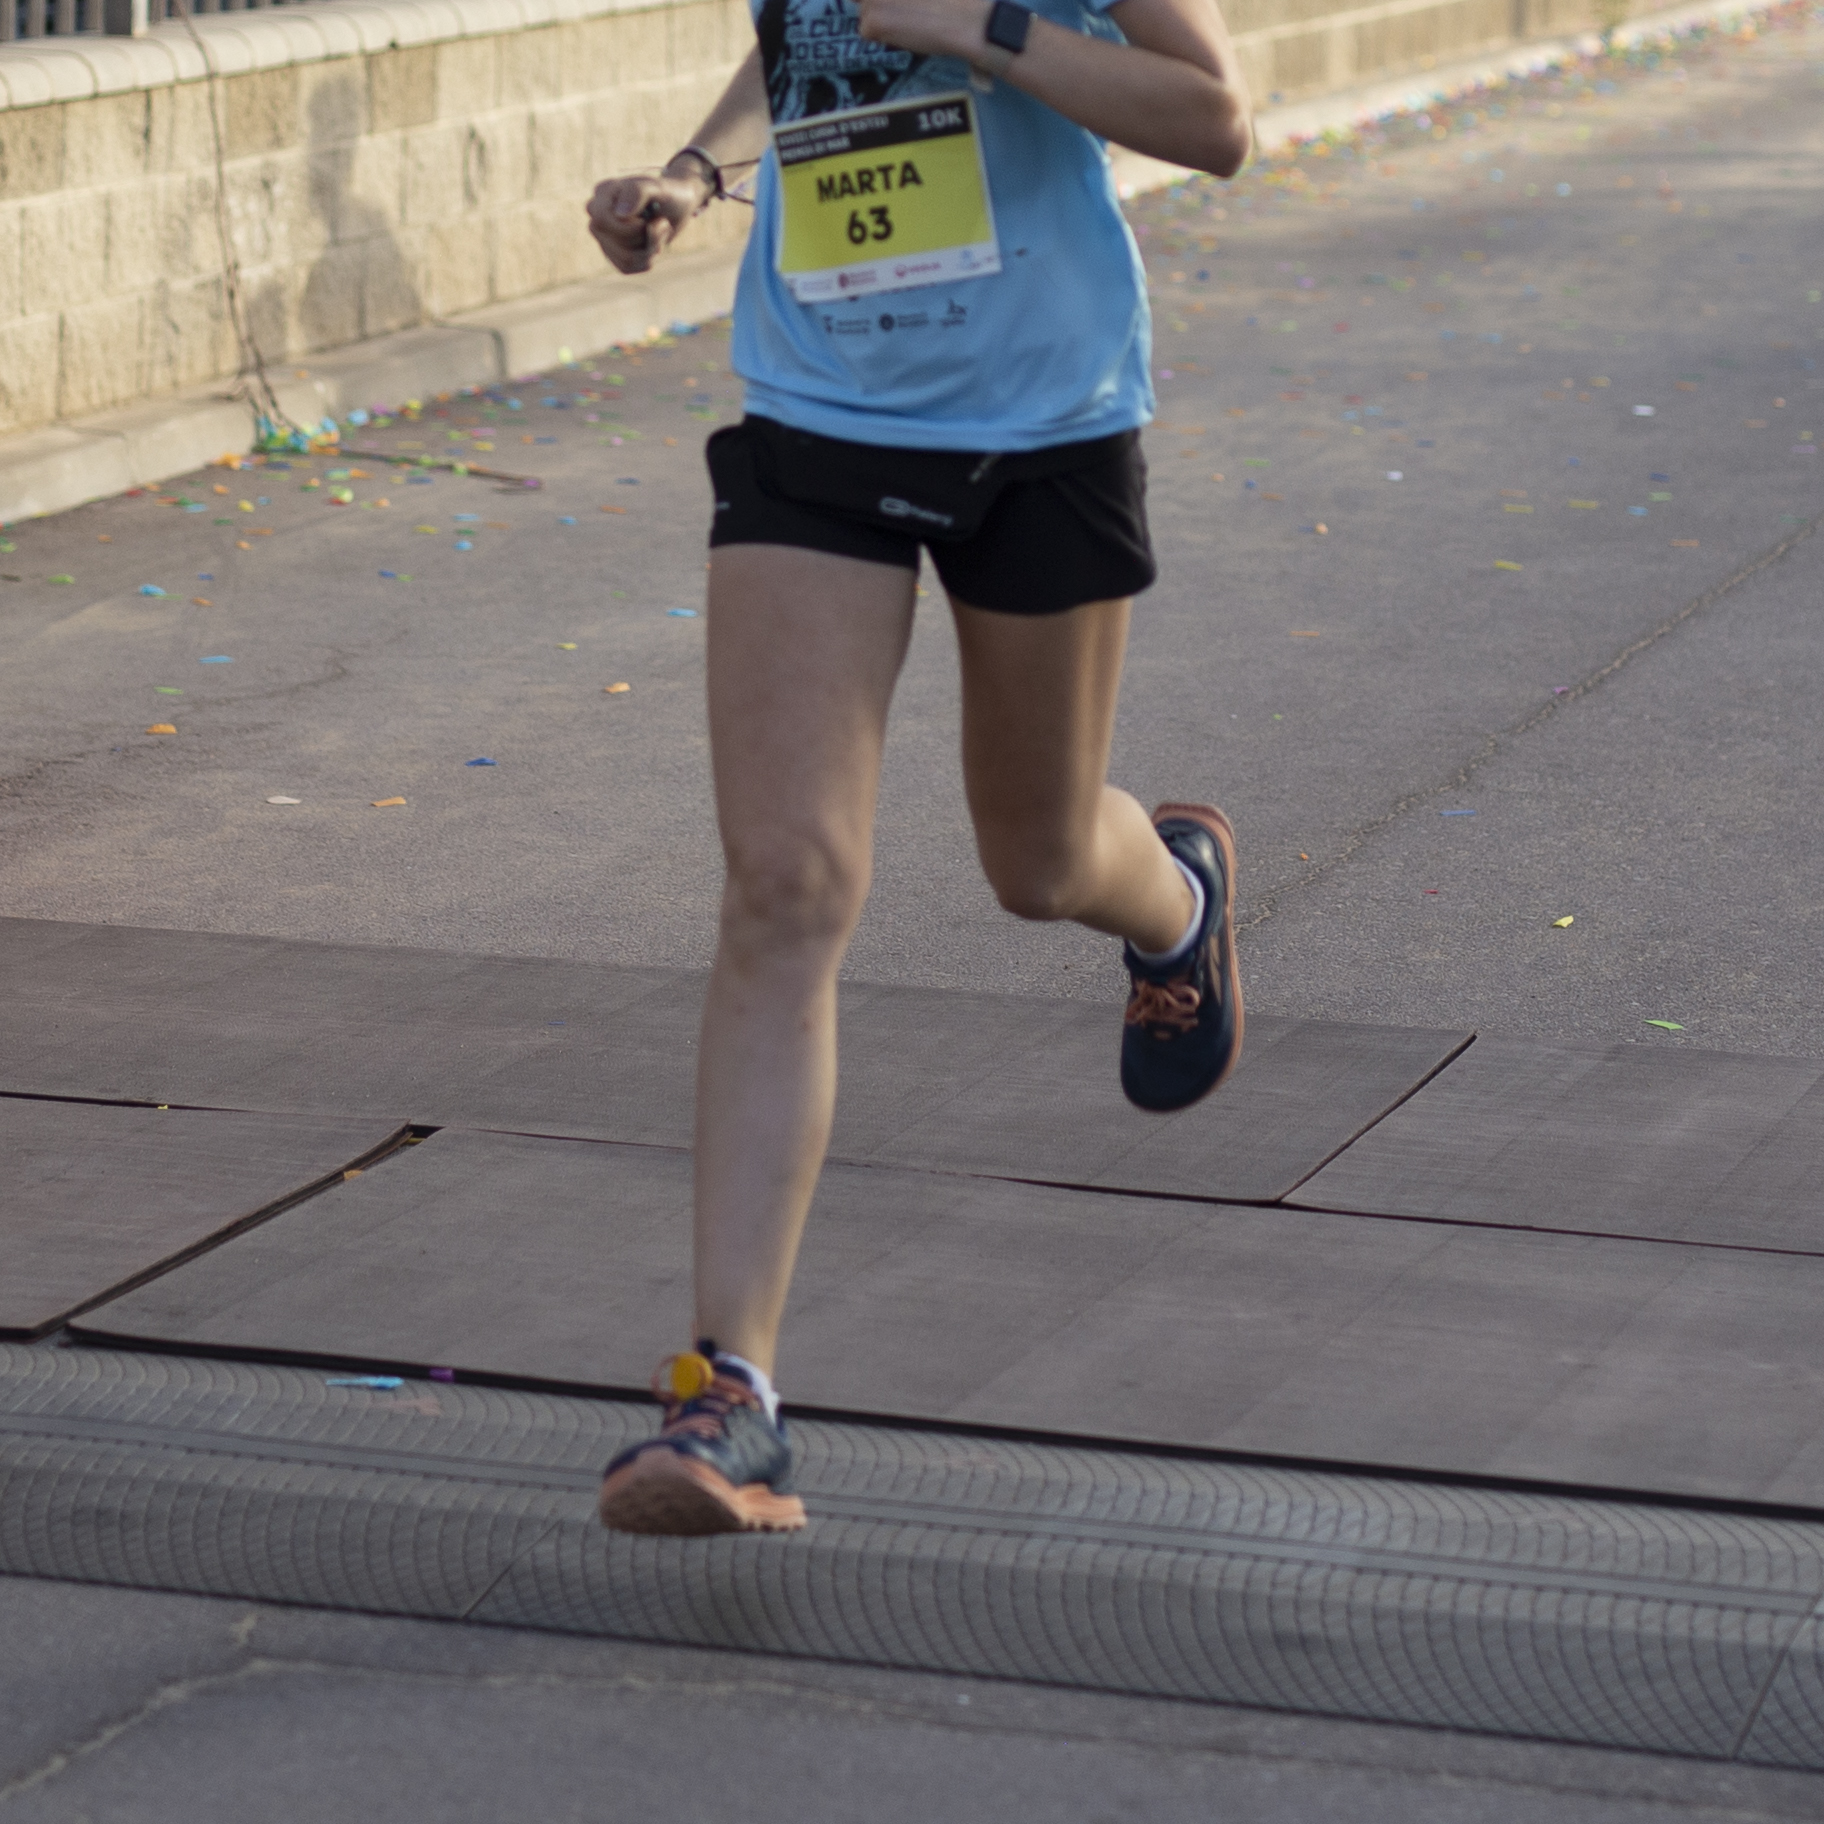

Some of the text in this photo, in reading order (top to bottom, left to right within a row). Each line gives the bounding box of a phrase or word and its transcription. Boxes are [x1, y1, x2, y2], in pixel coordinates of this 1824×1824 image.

[917, 106, 963, 131] 10K
[817, 160, 923, 203] MARTA
[847, 206, 893, 245] 63
